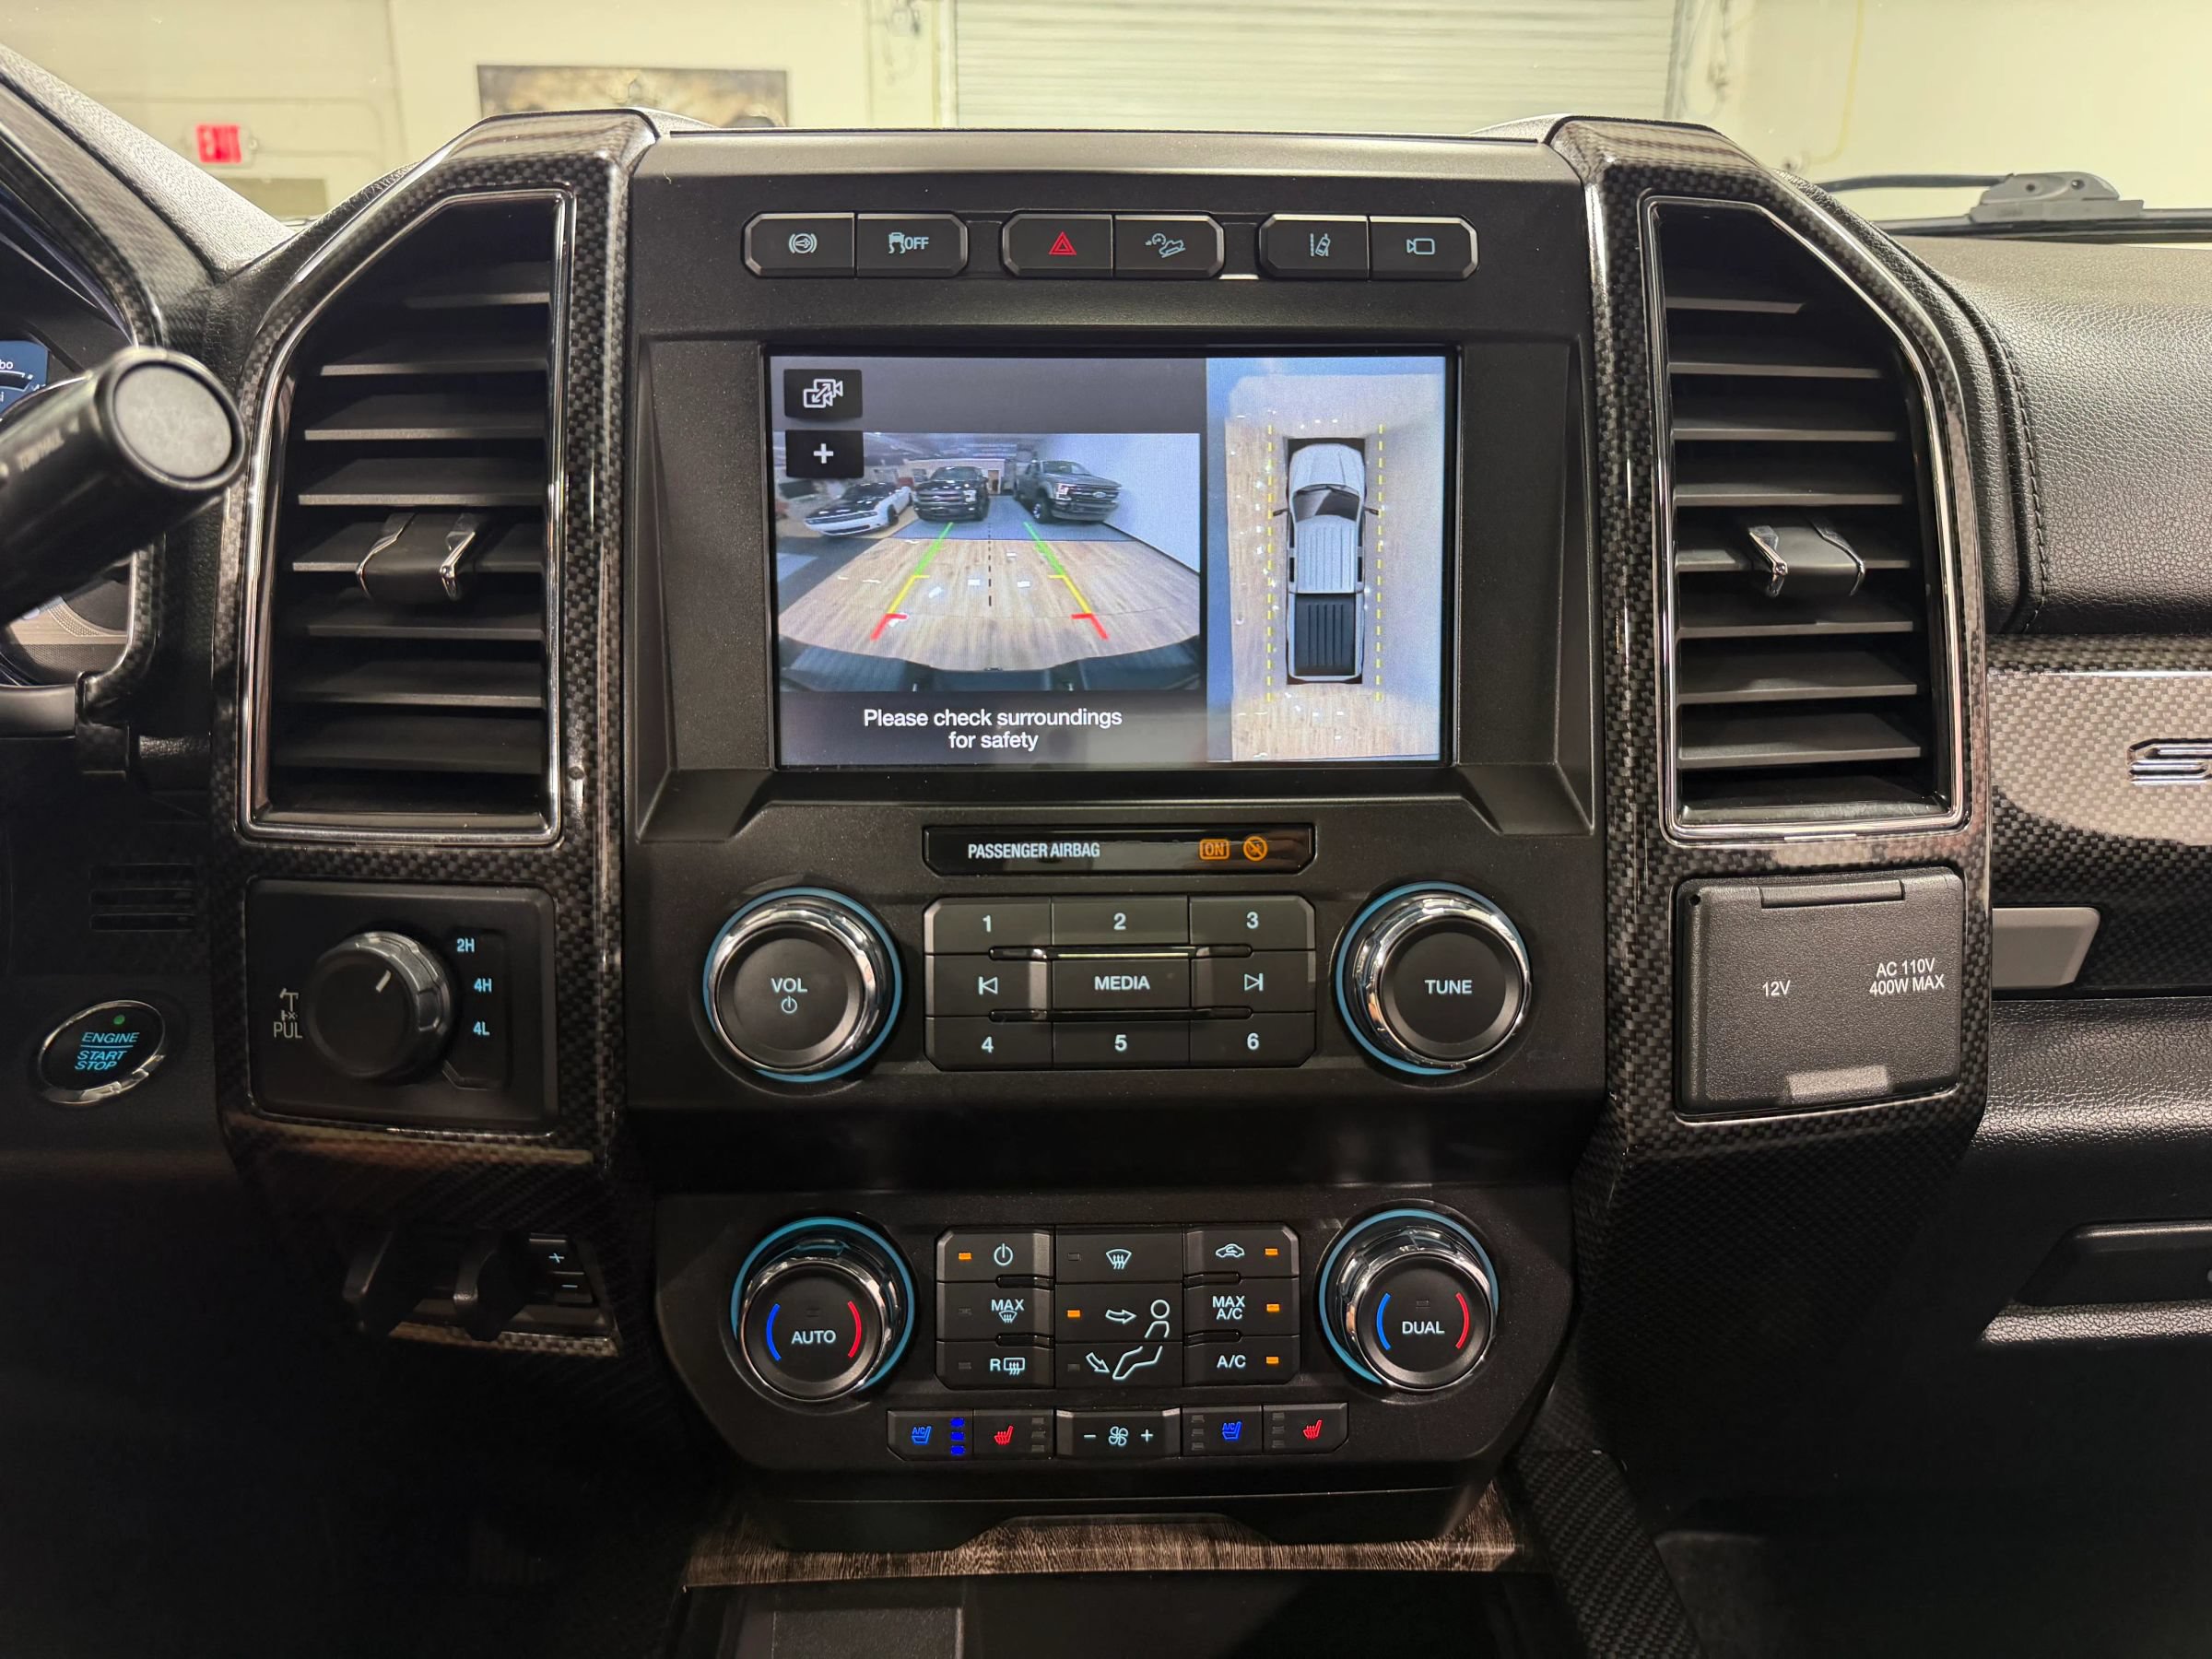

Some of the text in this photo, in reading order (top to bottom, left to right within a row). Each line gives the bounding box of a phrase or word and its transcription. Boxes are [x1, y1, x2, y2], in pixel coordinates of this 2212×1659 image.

[904, 236, 929, 250] OFF
[864, 708, 1123, 729] Please check surroundings
[948, 731, 1039, 752] for safety
[968, 841, 1100, 859] PASSENGER AIRBAG
[1205, 842, 1224, 856] ON
[982, 914, 992, 933] 1
[1113, 912, 1126, 931] 2
[1246, 911, 1259, 929] 3
[456, 937, 476, 953] 2H
[1876, 957, 1936, 978] AC 110V
[474, 978, 492, 993] 4H
[771, 977, 808, 994] VOL
[1094, 975, 1150, 991] MEDIA
[1424, 979, 1473, 994] TUNE
[1762, 979, 1791, 997] 12V
[1869, 973, 1945, 996] 400W MAX
[473, 1020, 490, 1035] 4L
[81, 1031, 140, 1043] ENGINE
[981, 1036, 995, 1053] 4
[1114, 1034, 1127, 1052] 5
[1247, 1032, 1260, 1051] 6
[76, 1050, 128, 1061] START
[74, 1061, 118, 1071] STOP
[991, 1299, 1025, 1312] MAX
[1212, 1295, 1246, 1308] MAX
[1216, 1307, 1243, 1320] A/C
[1402, 1321, 1445, 1335] DUAL
[791, 1329, 837, 1345] AUTO
[989, 1358, 1001, 1371] R
[1217, 1354, 1246, 1369] A/C
